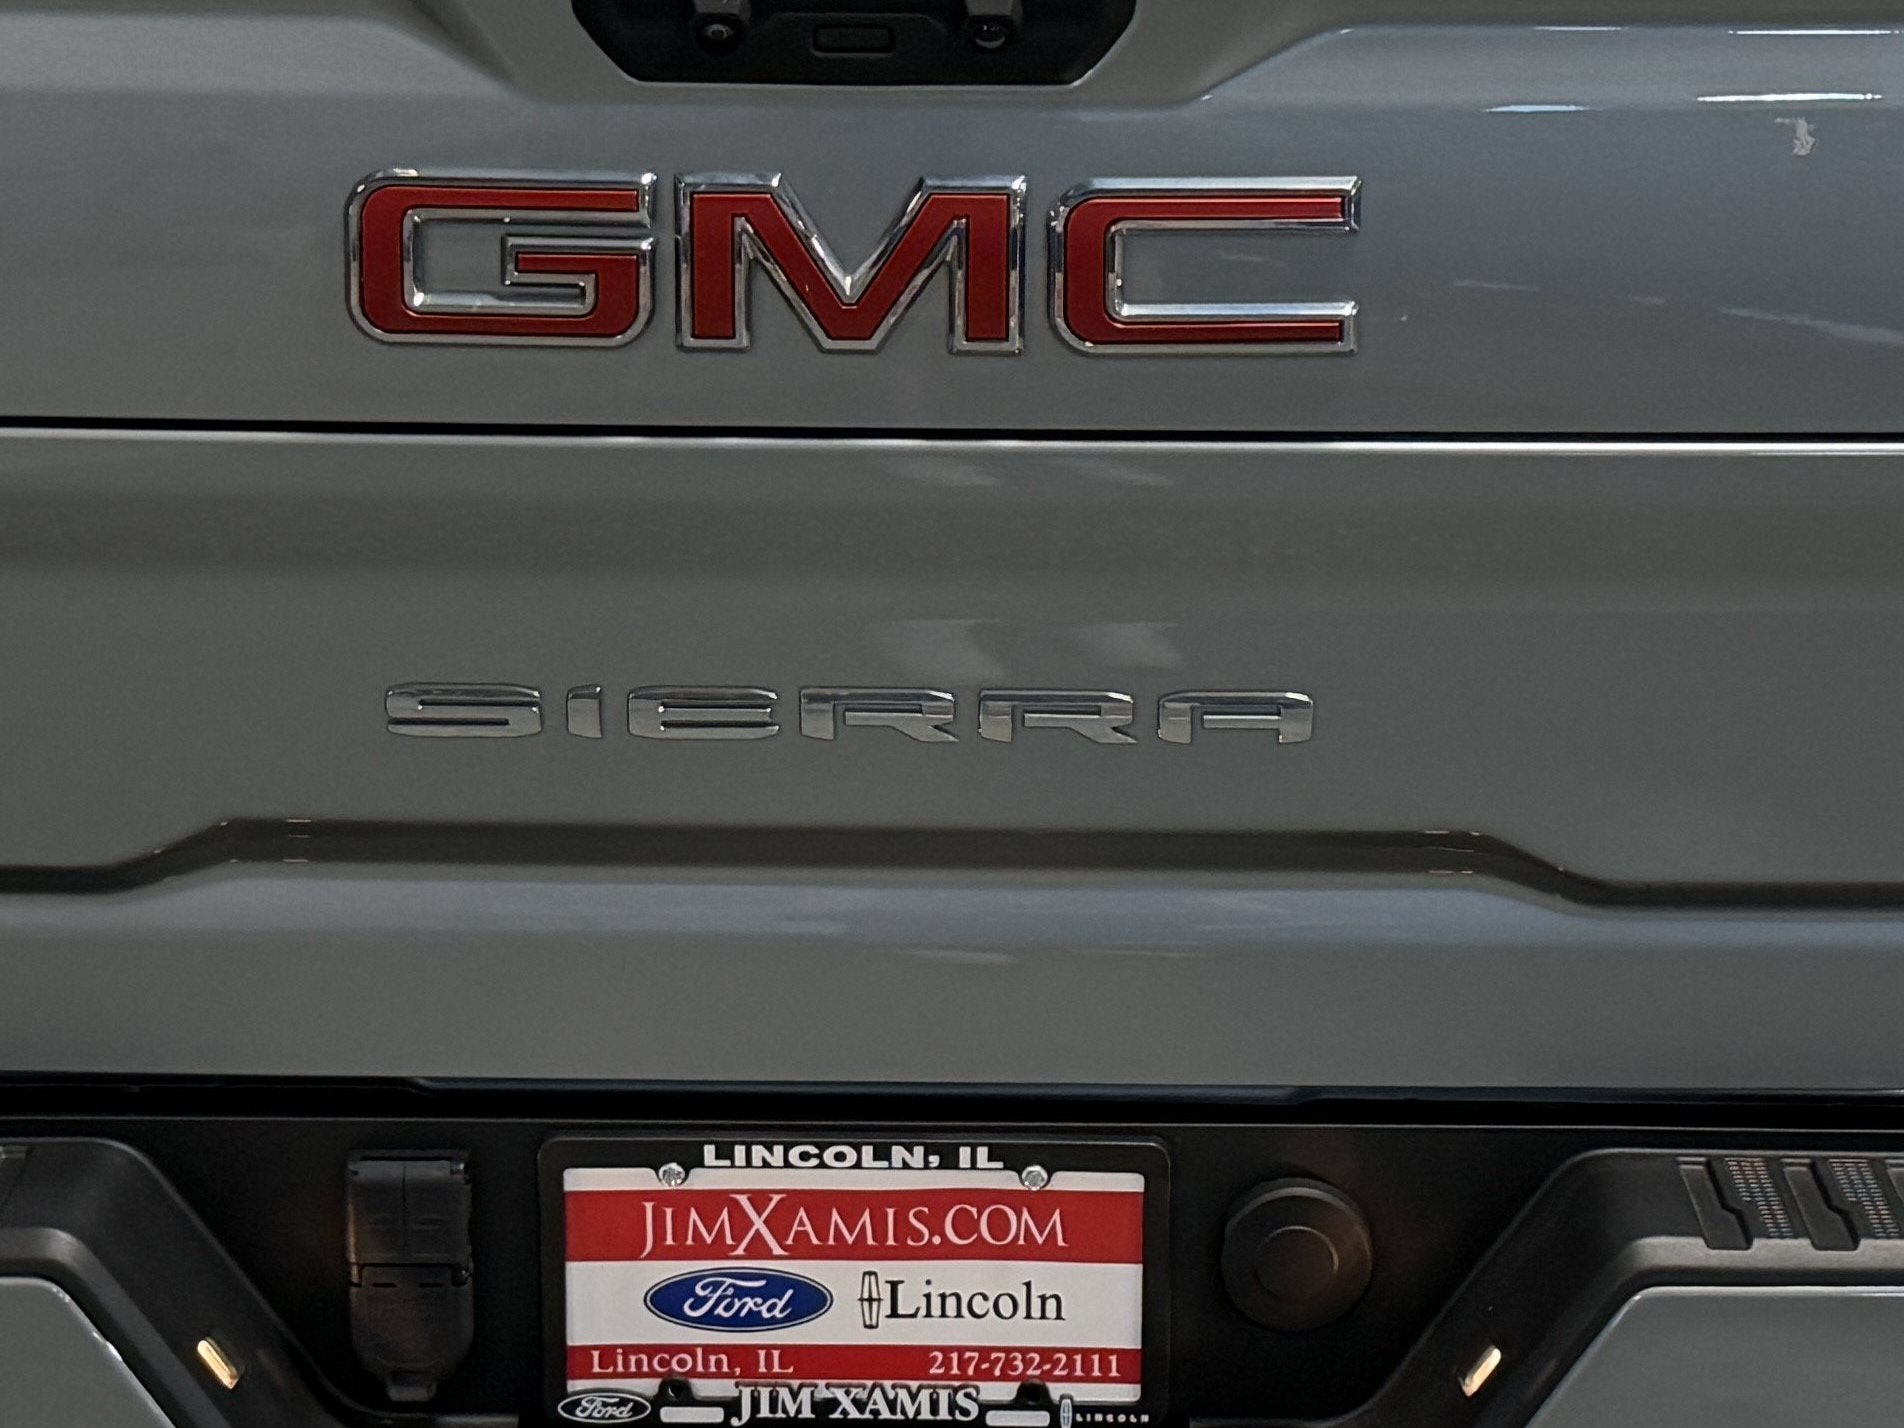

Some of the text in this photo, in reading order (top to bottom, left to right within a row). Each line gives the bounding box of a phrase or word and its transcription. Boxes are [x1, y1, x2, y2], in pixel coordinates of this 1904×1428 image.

[345, 168, 1362, 356] GMC
[385, 681, 1314, 745] SIERRA
[703, 1144, 1004, 1169] LINCOLN, IL
[640, 1193, 1069, 1259] JIMXAMIS.COM
[683, 1277, 1066, 1321] Ford Lincoln
[591, 1347, 1122, 1377] Lincoln, IL 217-732-2111
[575, 1384, 1150, 1427] Ford JIM XAMIS LINCOLN
